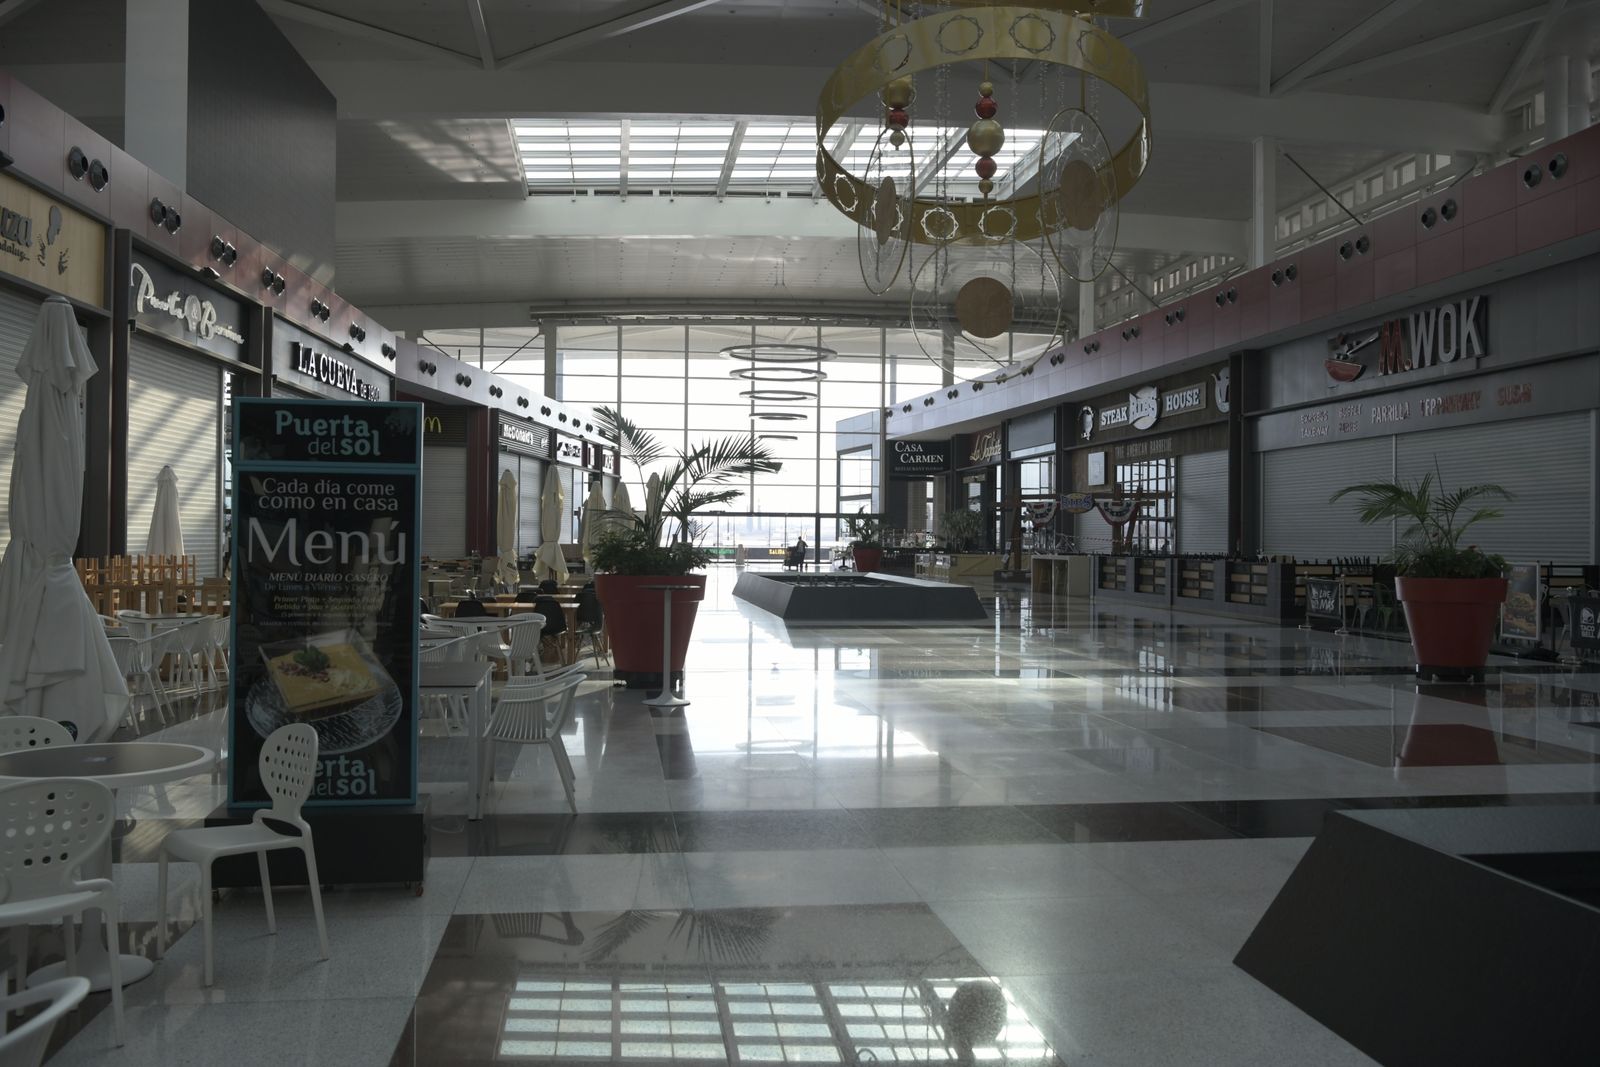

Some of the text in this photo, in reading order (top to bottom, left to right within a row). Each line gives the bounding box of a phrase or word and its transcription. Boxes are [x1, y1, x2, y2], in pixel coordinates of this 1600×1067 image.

[298, 342, 317, 378] LA
[320, 353, 358, 395] CUEVA
[360, 383, 367, 398] de
[1100, 387, 1200, 426] STEAK RIBS HOUSE
[1371, 402, 1410, 424] PARRILLA
[274, 409, 370, 438] Puerta
[307, 429, 381, 457] del sol
[262, 478, 395, 496] Cada día come
[258, 495, 399, 512] como en casa
[247, 517, 407, 567] Menú
[263, 583, 276, 591] De
[268, 572, 303, 583] MENÚ
[304, 573, 343, 583] DIARIO
[313, 754, 366, 777] erta
[311, 769, 377, 796] el sol
